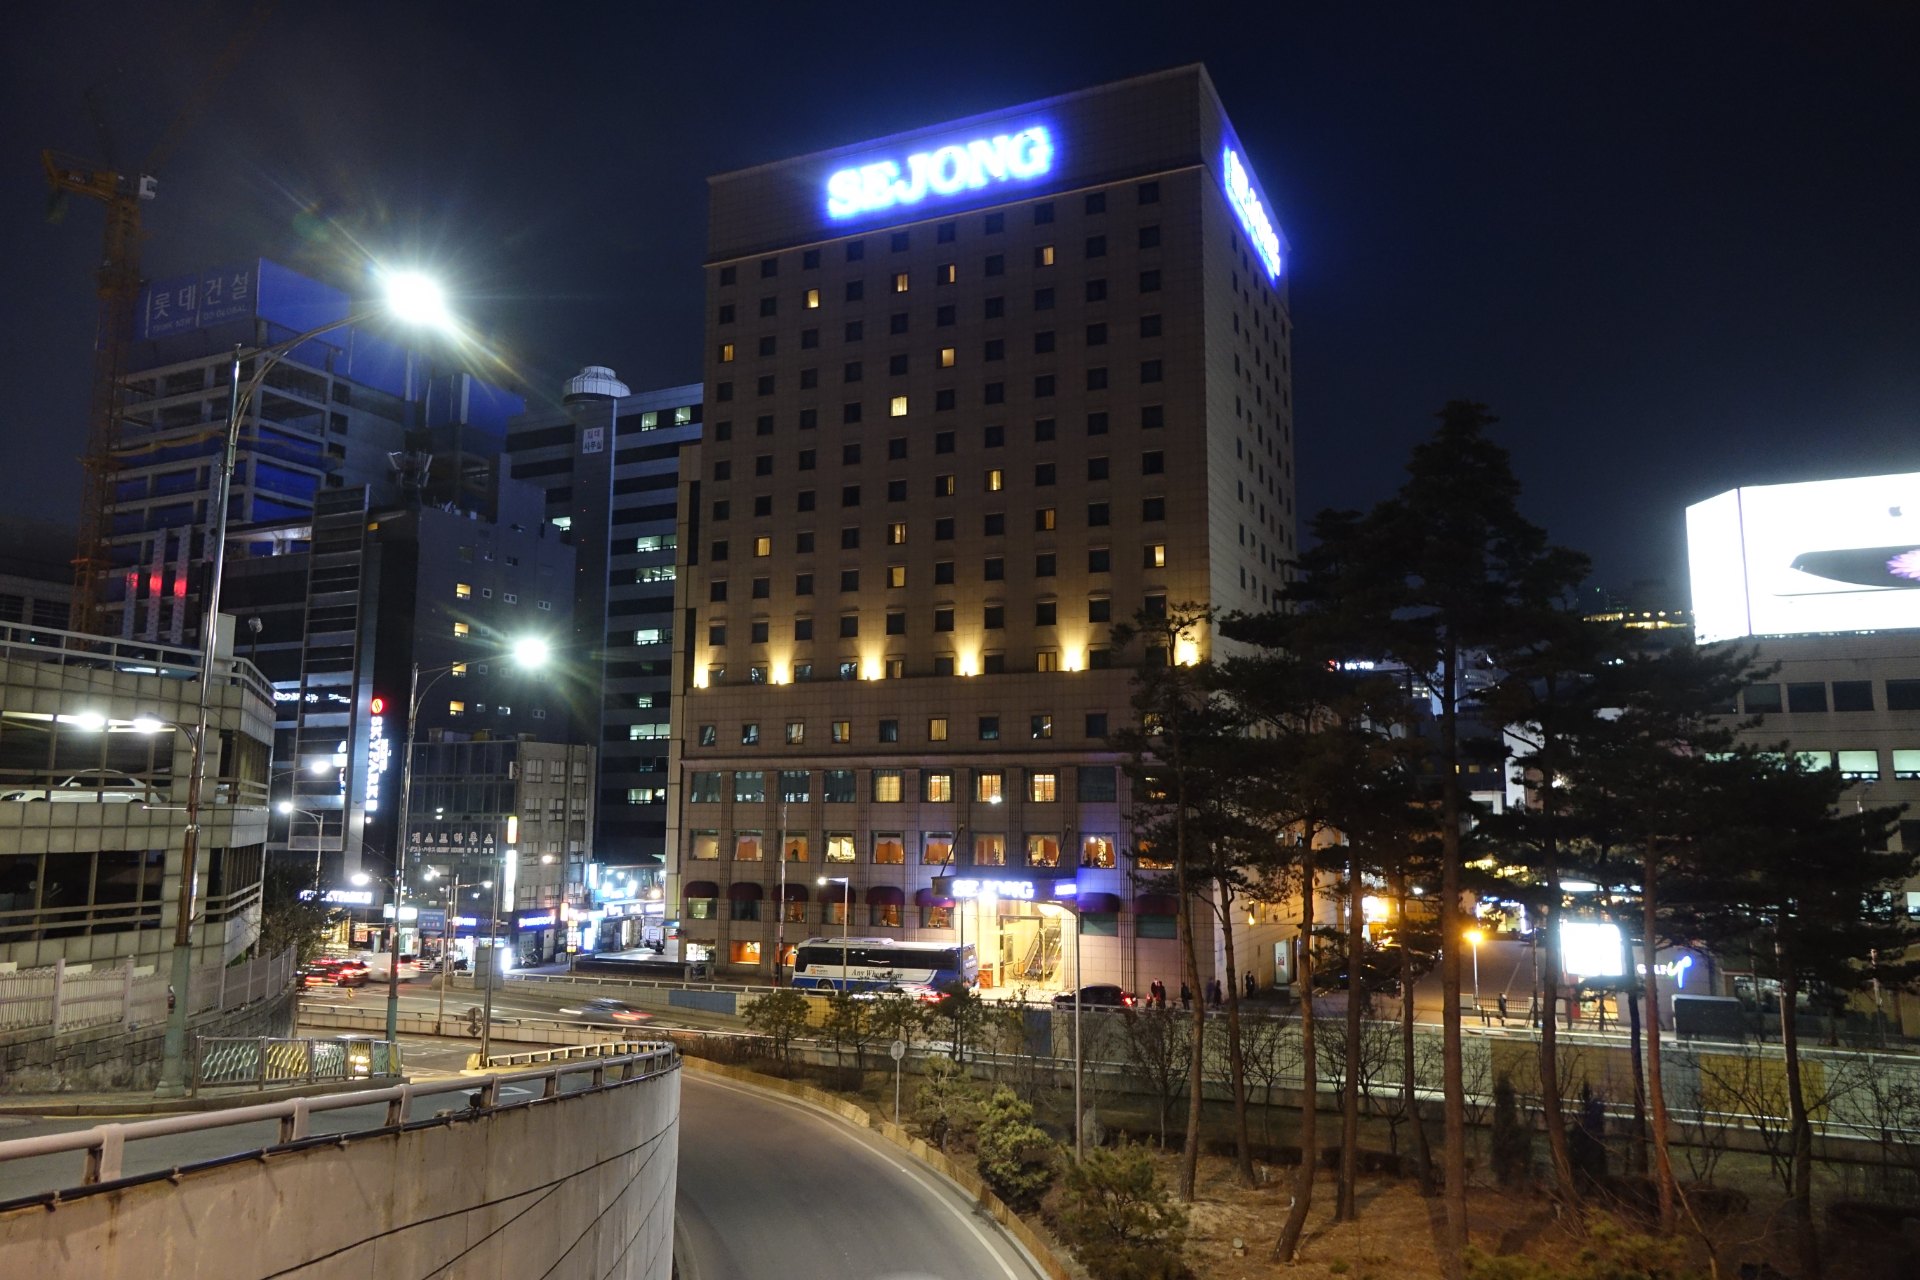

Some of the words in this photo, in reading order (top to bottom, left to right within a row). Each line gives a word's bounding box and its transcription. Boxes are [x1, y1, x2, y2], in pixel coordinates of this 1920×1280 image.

[827, 123, 1054, 220] SEJONG
[153, 271, 249, 321] 롯데건설
[365, 716, 383, 799] SKYPARK
[1636, 963, 1667, 975] GLF
